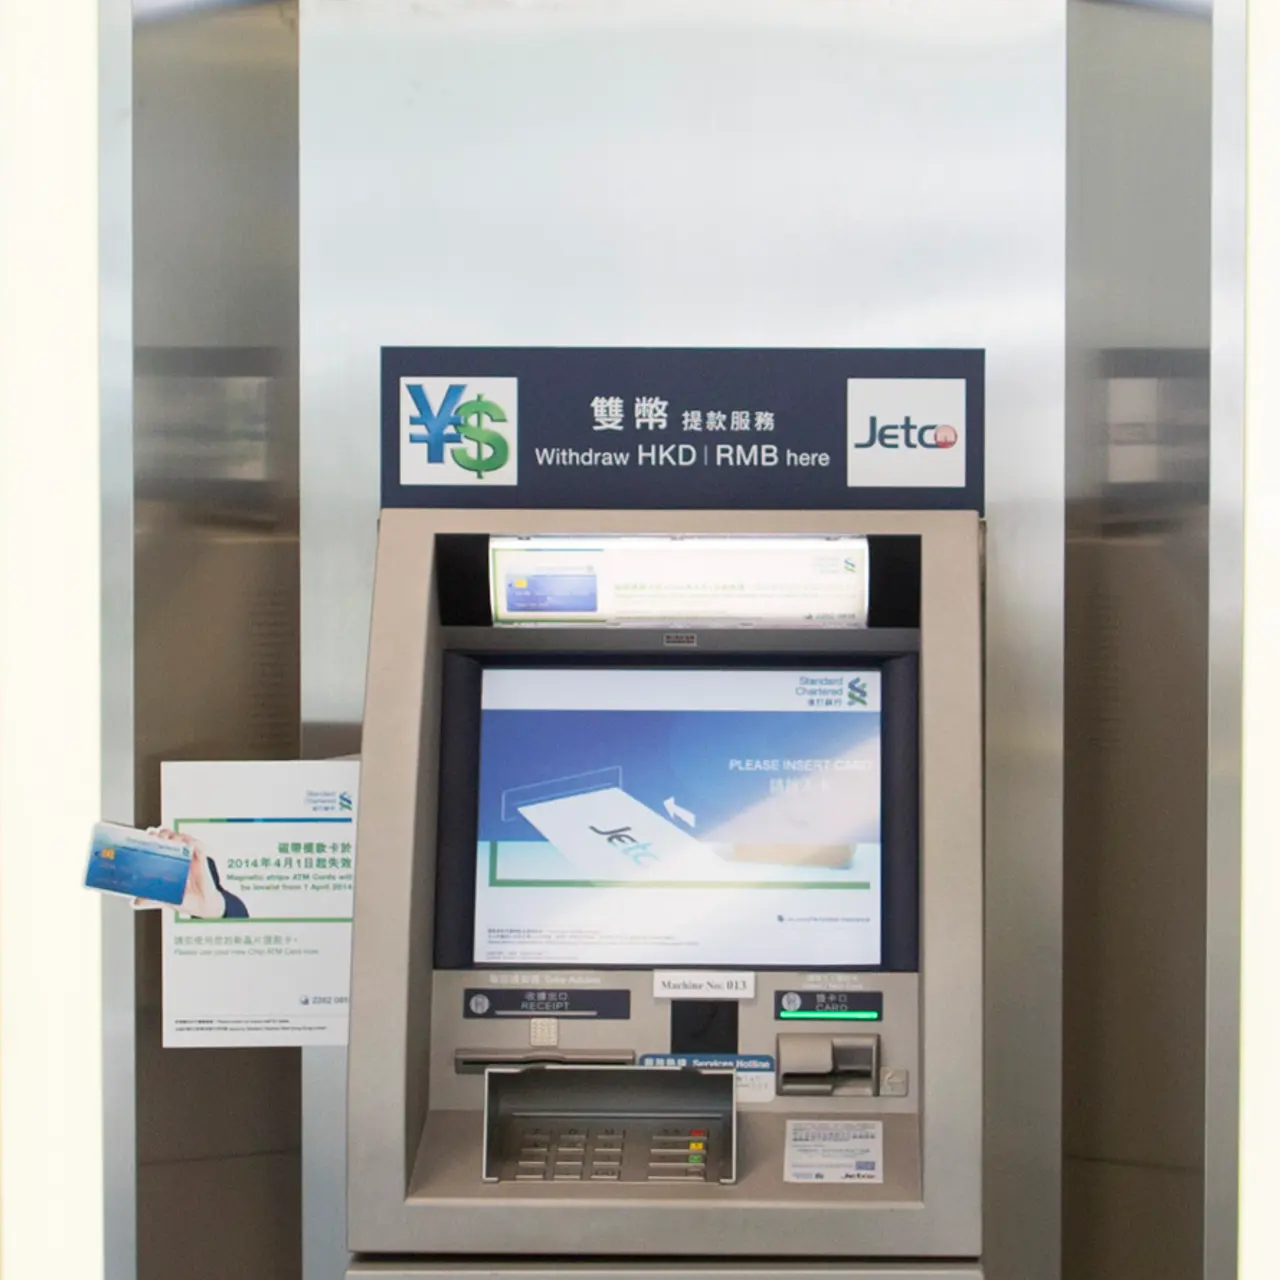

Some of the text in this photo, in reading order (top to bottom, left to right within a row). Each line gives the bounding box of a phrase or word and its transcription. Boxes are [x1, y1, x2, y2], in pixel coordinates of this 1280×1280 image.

[590, 396, 776, 432] 雙幣 提款服務
[535, 444, 831, 468] Withdraw HKD RMB here
[799, 676, 843, 687] Standard
[795, 686, 843, 697] Chartered
[728, 759, 780, 771] PLEASE
[782, 759, 830, 771] INSERT
[292, 873, 311, 881] ATM
[661, 979, 704, 991] Machine
[726, 979, 749, 991] 013
[520, 1001, 570, 1011] RECEIPT
[692, 1058, 734, 1068] Services
